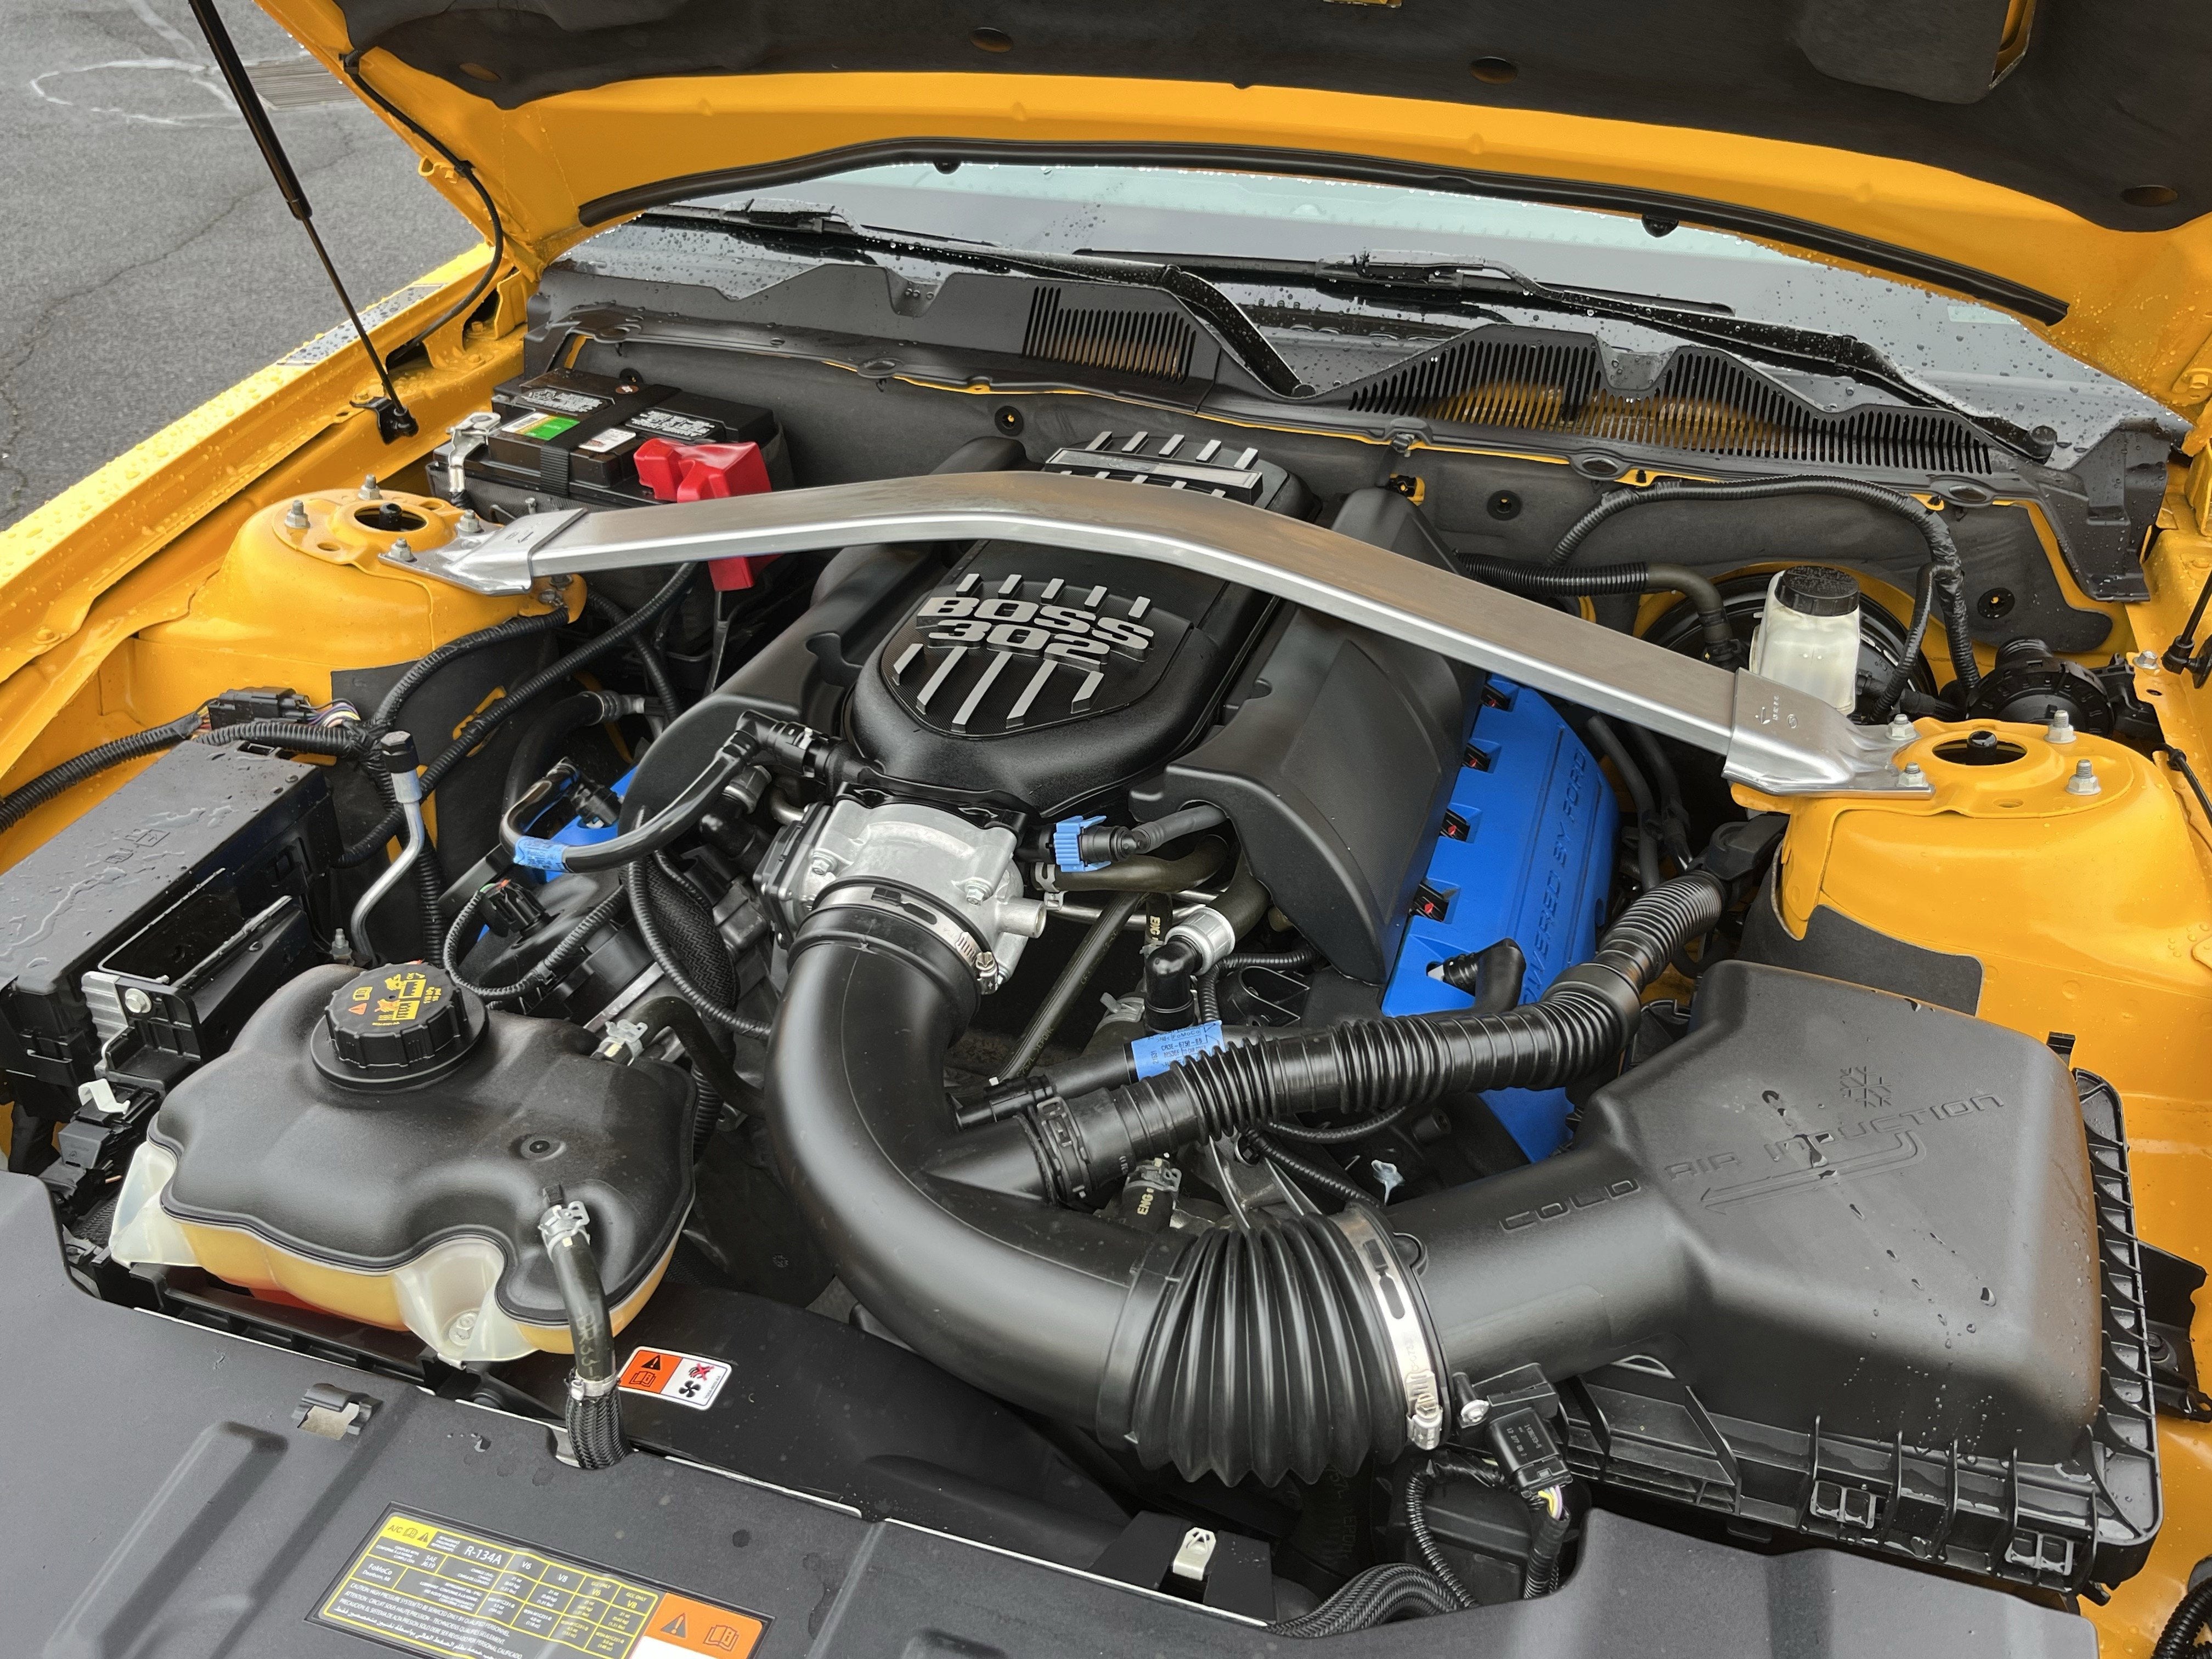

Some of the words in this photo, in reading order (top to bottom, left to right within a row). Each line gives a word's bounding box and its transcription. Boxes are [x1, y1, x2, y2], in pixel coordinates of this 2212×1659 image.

[917, 597, 1155, 652] BOSS
[928, 619, 1111, 665] 302
[1523, 870, 1561, 1006] OWERED
[1553, 821, 1570, 869] BY
[1562, 748, 1586, 823] FORD
[1150, 915, 1160, 935] ENG
[1172, 1030, 1200, 1039] FoMoCo
[1503, 1177, 1641, 1232] COLD
[1664, 1150, 1743, 1180] AIR
[1763, 1092, 2005, 1160] INDUCTION
[1137, 1194, 1154, 1215] ENG
[387, 1525, 403, 1533] A/C
[420, 1560, 436, 1568] J639
[464, 1545, 502, 1565] R-134A
[368, 1563, 393, 1575] FoMoCo
[522, 1561, 532, 1570] V6
[558, 1573, 568, 1583] V8
[368, 1598, 386, 1607] CIRCUIT
[395, 1606, 410, 1615] HAUTE
[408, 1610, 431, 1621] PRESSION
[380, 1592, 401, 1602] PRESSURE
[399, 1598, 417, 1607] SYSTEM
[427, 1606, 448, 1617] SERVICED
[627, 1600, 637, 1609] V8
[369, 1607, 387, 1617] SISTEMA
[474, 1639, 497, 1651] PERSONAL
